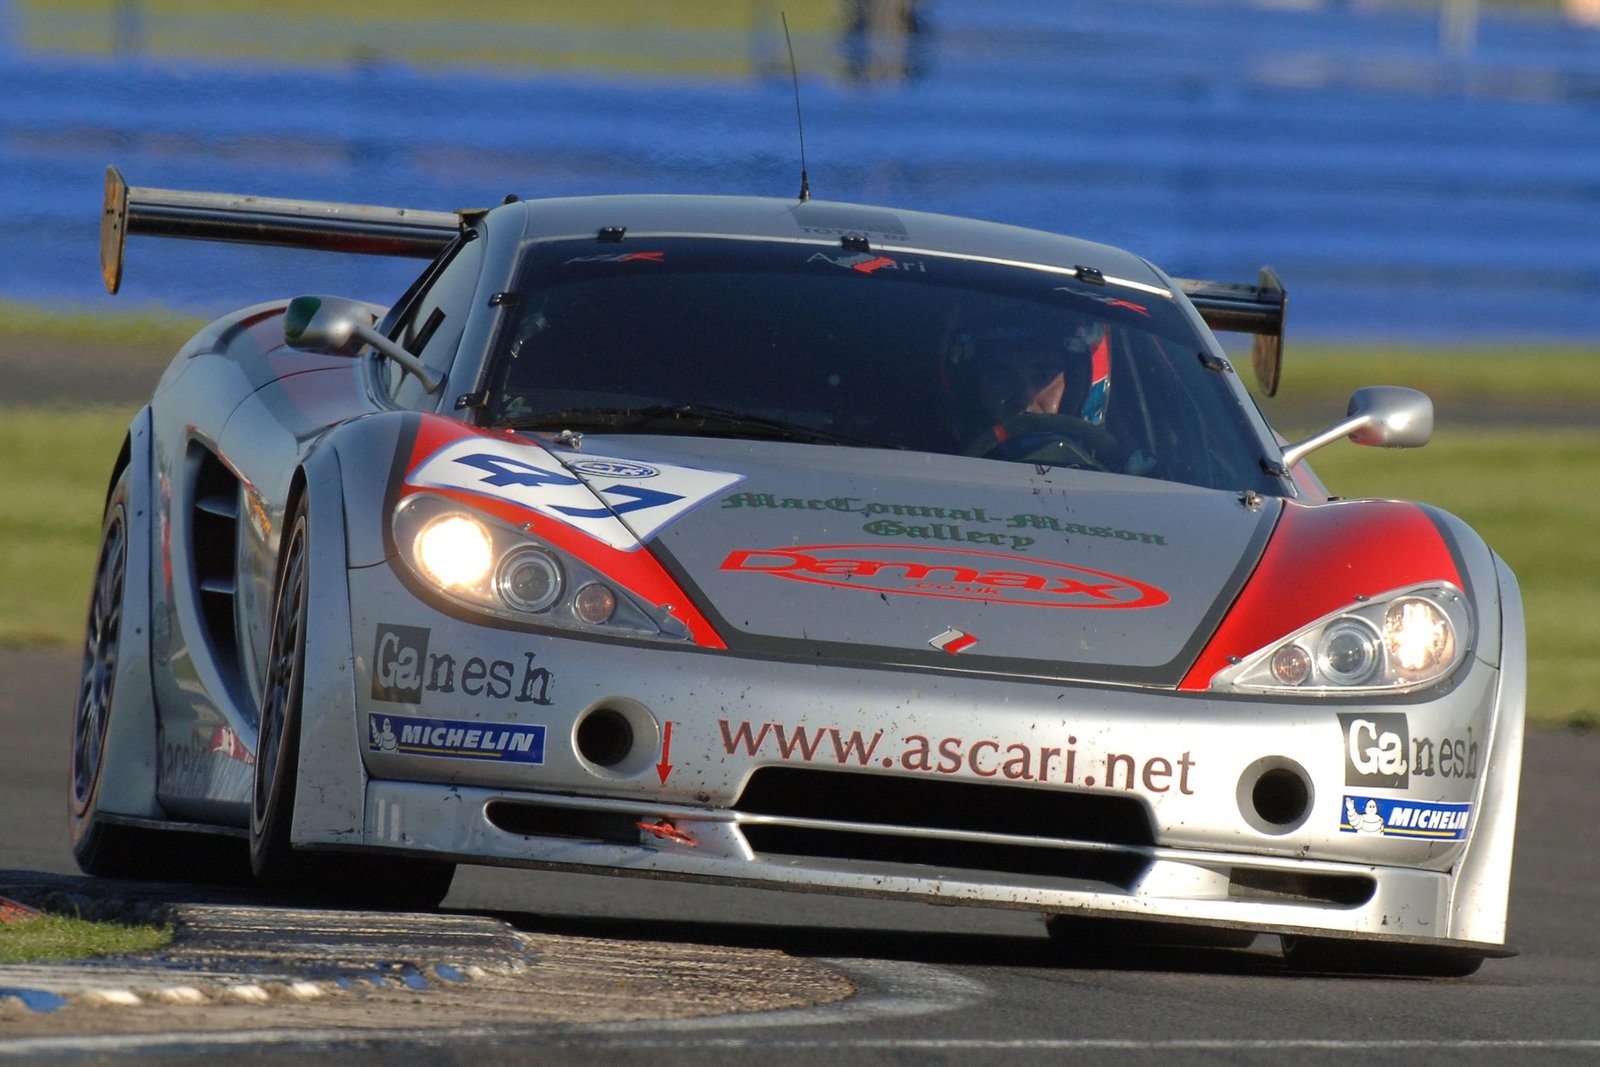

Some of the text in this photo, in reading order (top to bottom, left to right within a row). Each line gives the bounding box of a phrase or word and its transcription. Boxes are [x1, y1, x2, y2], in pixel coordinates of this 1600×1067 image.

[453, 453, 687, 519] 47
[721, 493, 1168, 545] MacConnal-Mason
[862, 520, 1036, 551] Gallery
[719, 550, 1129, 601] Damax
[376, 631, 556, 706] Ganesh
[401, 724, 535, 752] MICHELIN
[717, 719, 1196, 795] www.ascari.net
[1348, 718, 1478, 780] Ganesh
[1387, 806, 1470, 830] MICHELIN
